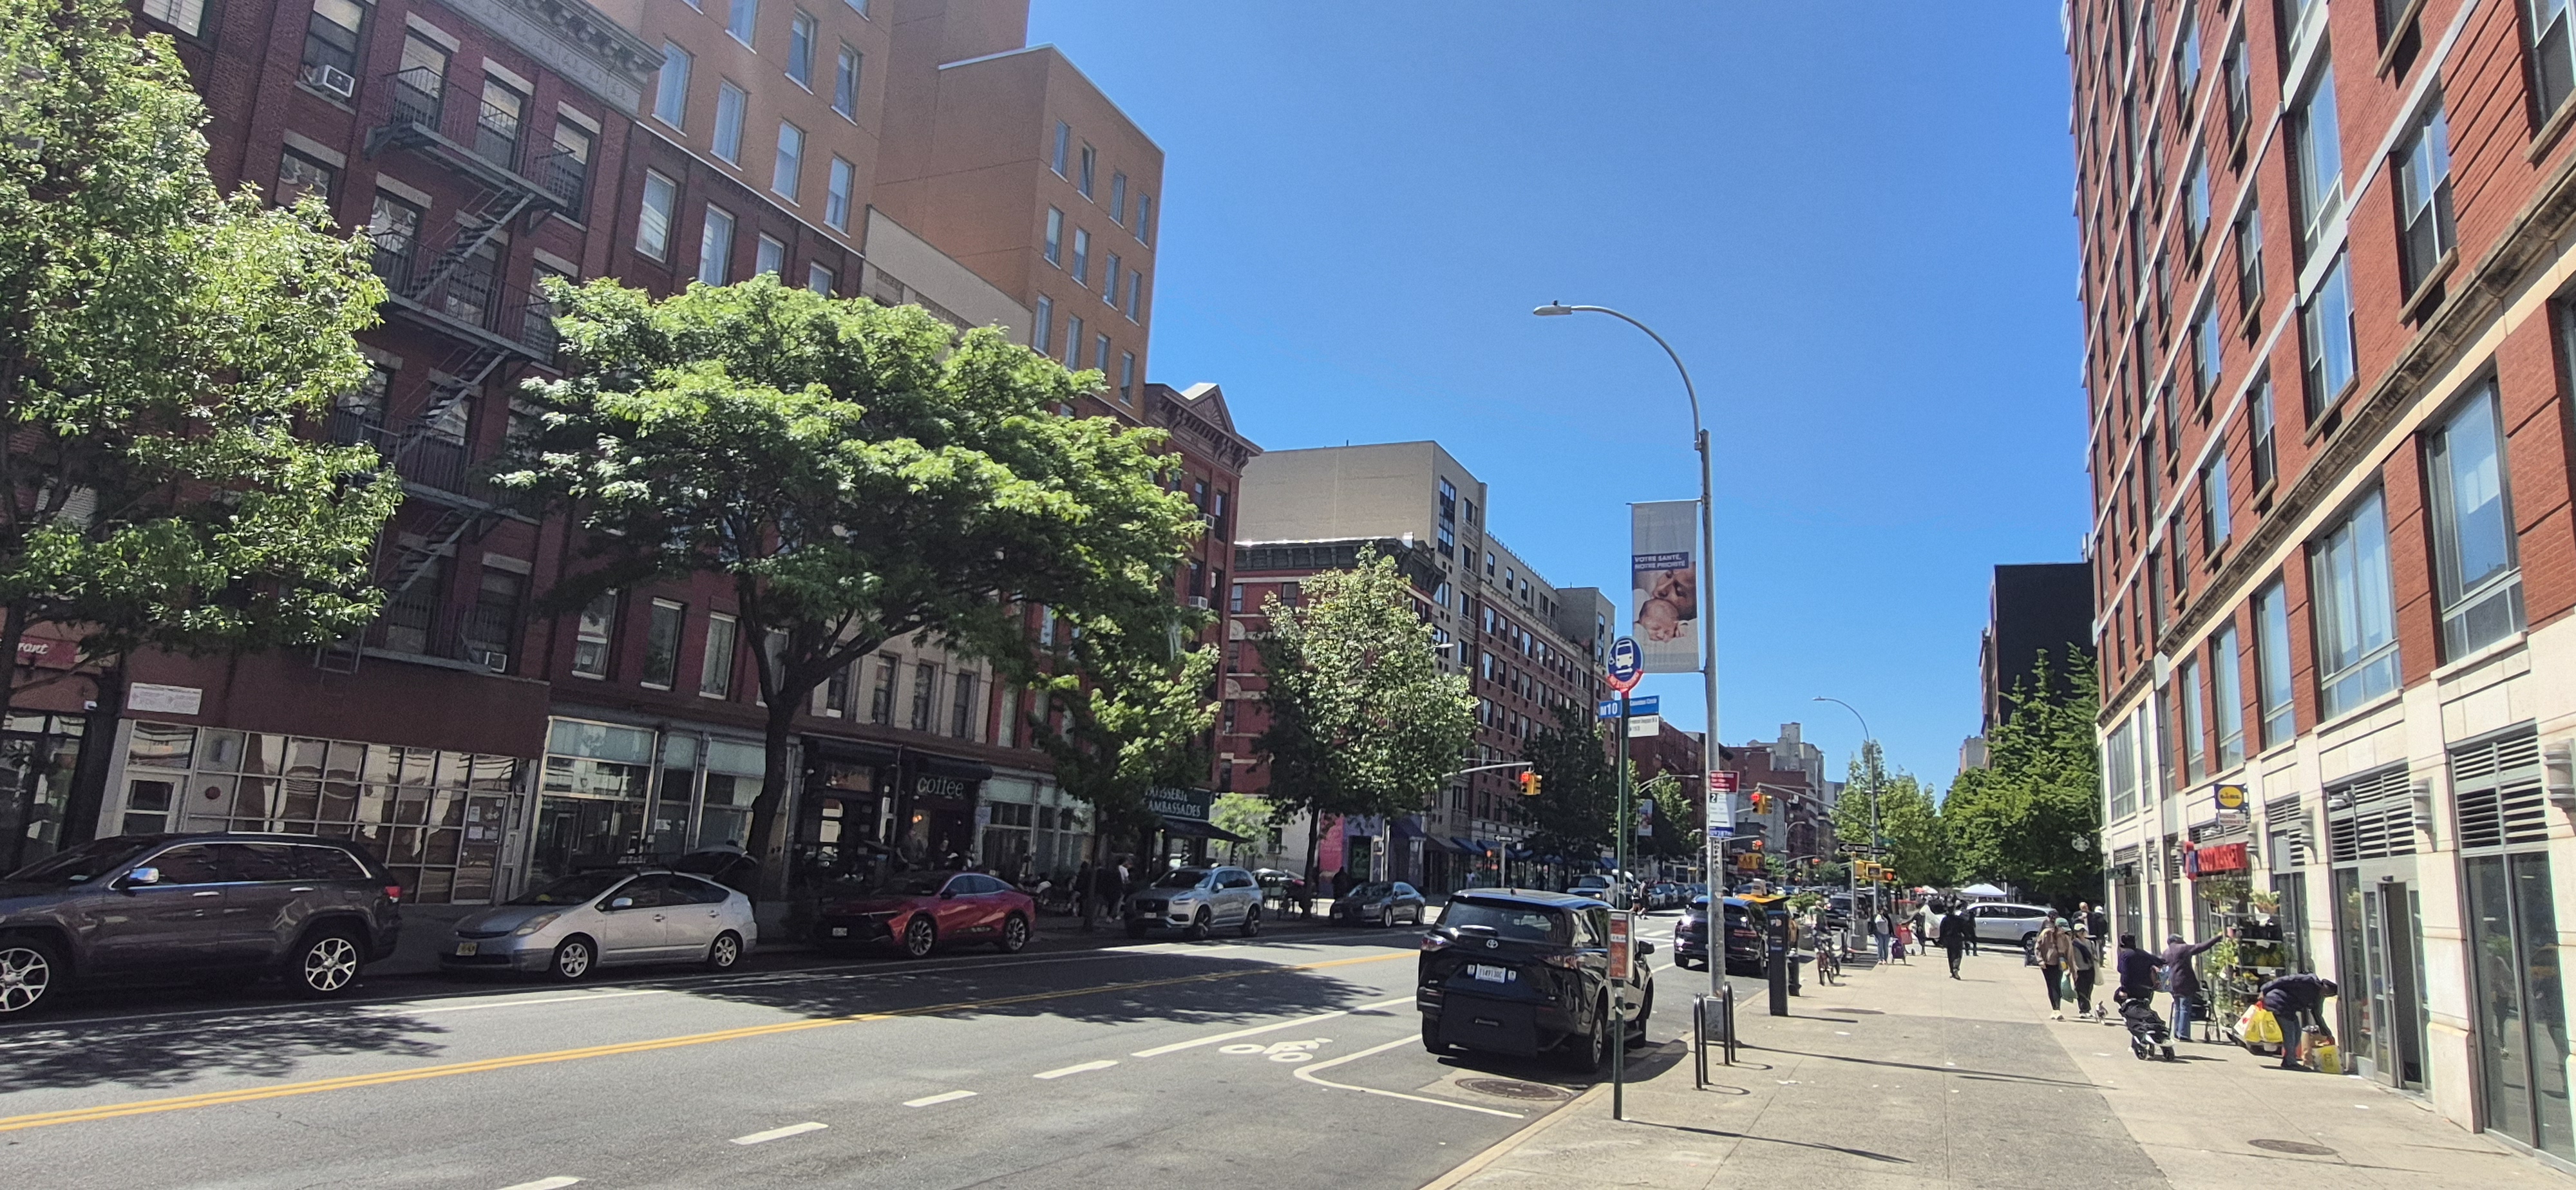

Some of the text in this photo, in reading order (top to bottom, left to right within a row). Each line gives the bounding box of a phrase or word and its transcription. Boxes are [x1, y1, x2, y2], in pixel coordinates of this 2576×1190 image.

[1600, 703, 1618, 716] M10
[1710, 793, 1716, 802] 2
[1148, 800, 1202, 817] AMBASSADES
